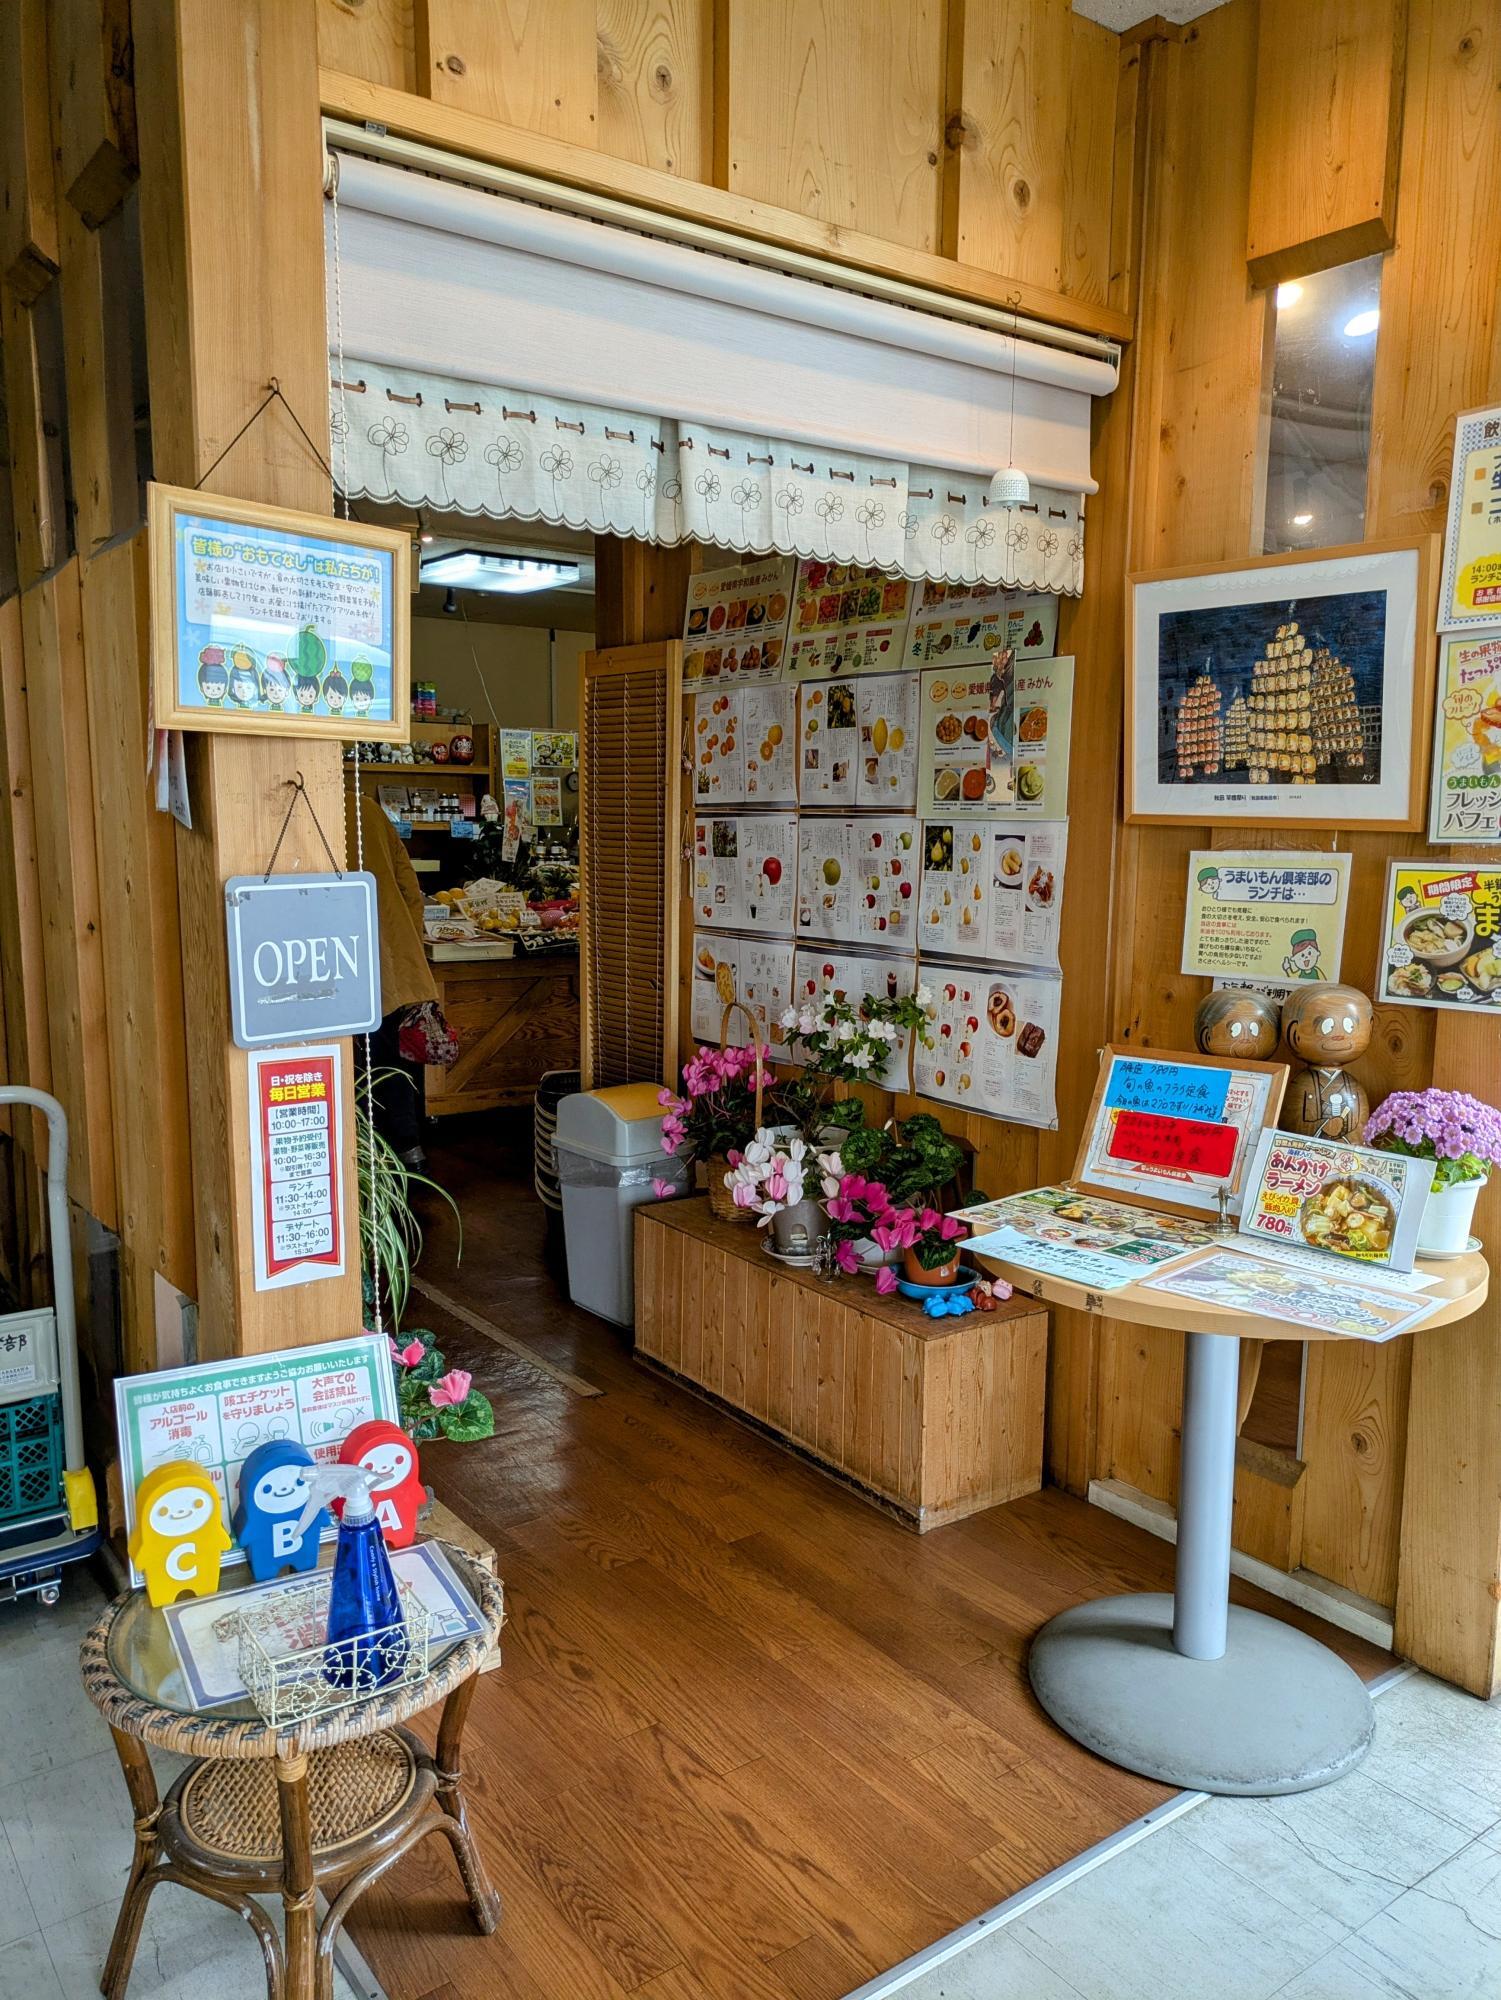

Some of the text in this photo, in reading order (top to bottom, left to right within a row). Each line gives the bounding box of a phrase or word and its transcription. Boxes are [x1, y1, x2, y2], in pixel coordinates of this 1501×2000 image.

[1027, 675, 1053, 690] みかん
[1443, 811, 1496, 830] パフェ
[1427, 877, 1473, 896] 期間限定
[253, 935, 360, 987] OPEN
[269, 1083, 326, 1102] 毎日営業
[1270, 1150, 1331, 1178] あんかけ
[288, 1181, 314, 1192] ランチ
[1266, 1170, 1322, 1197] ラーメン
[293, 1207, 312, 1216] 14:00
[285, 1219, 320, 1232] デザート
[1256, 1213, 1293, 1236] 780円
[312, 1372, 356, 1389] 大声での
[313, 1384, 358, 1402] 会話禁止
[223, 1398, 295, 1420] を守りましょう
[150, 1410, 208, 1430] アルコール
[168, 1425, 193, 1440] 消毒
[273, 1520, 303, 1558] B
[165, 1543, 197, 1580] C
